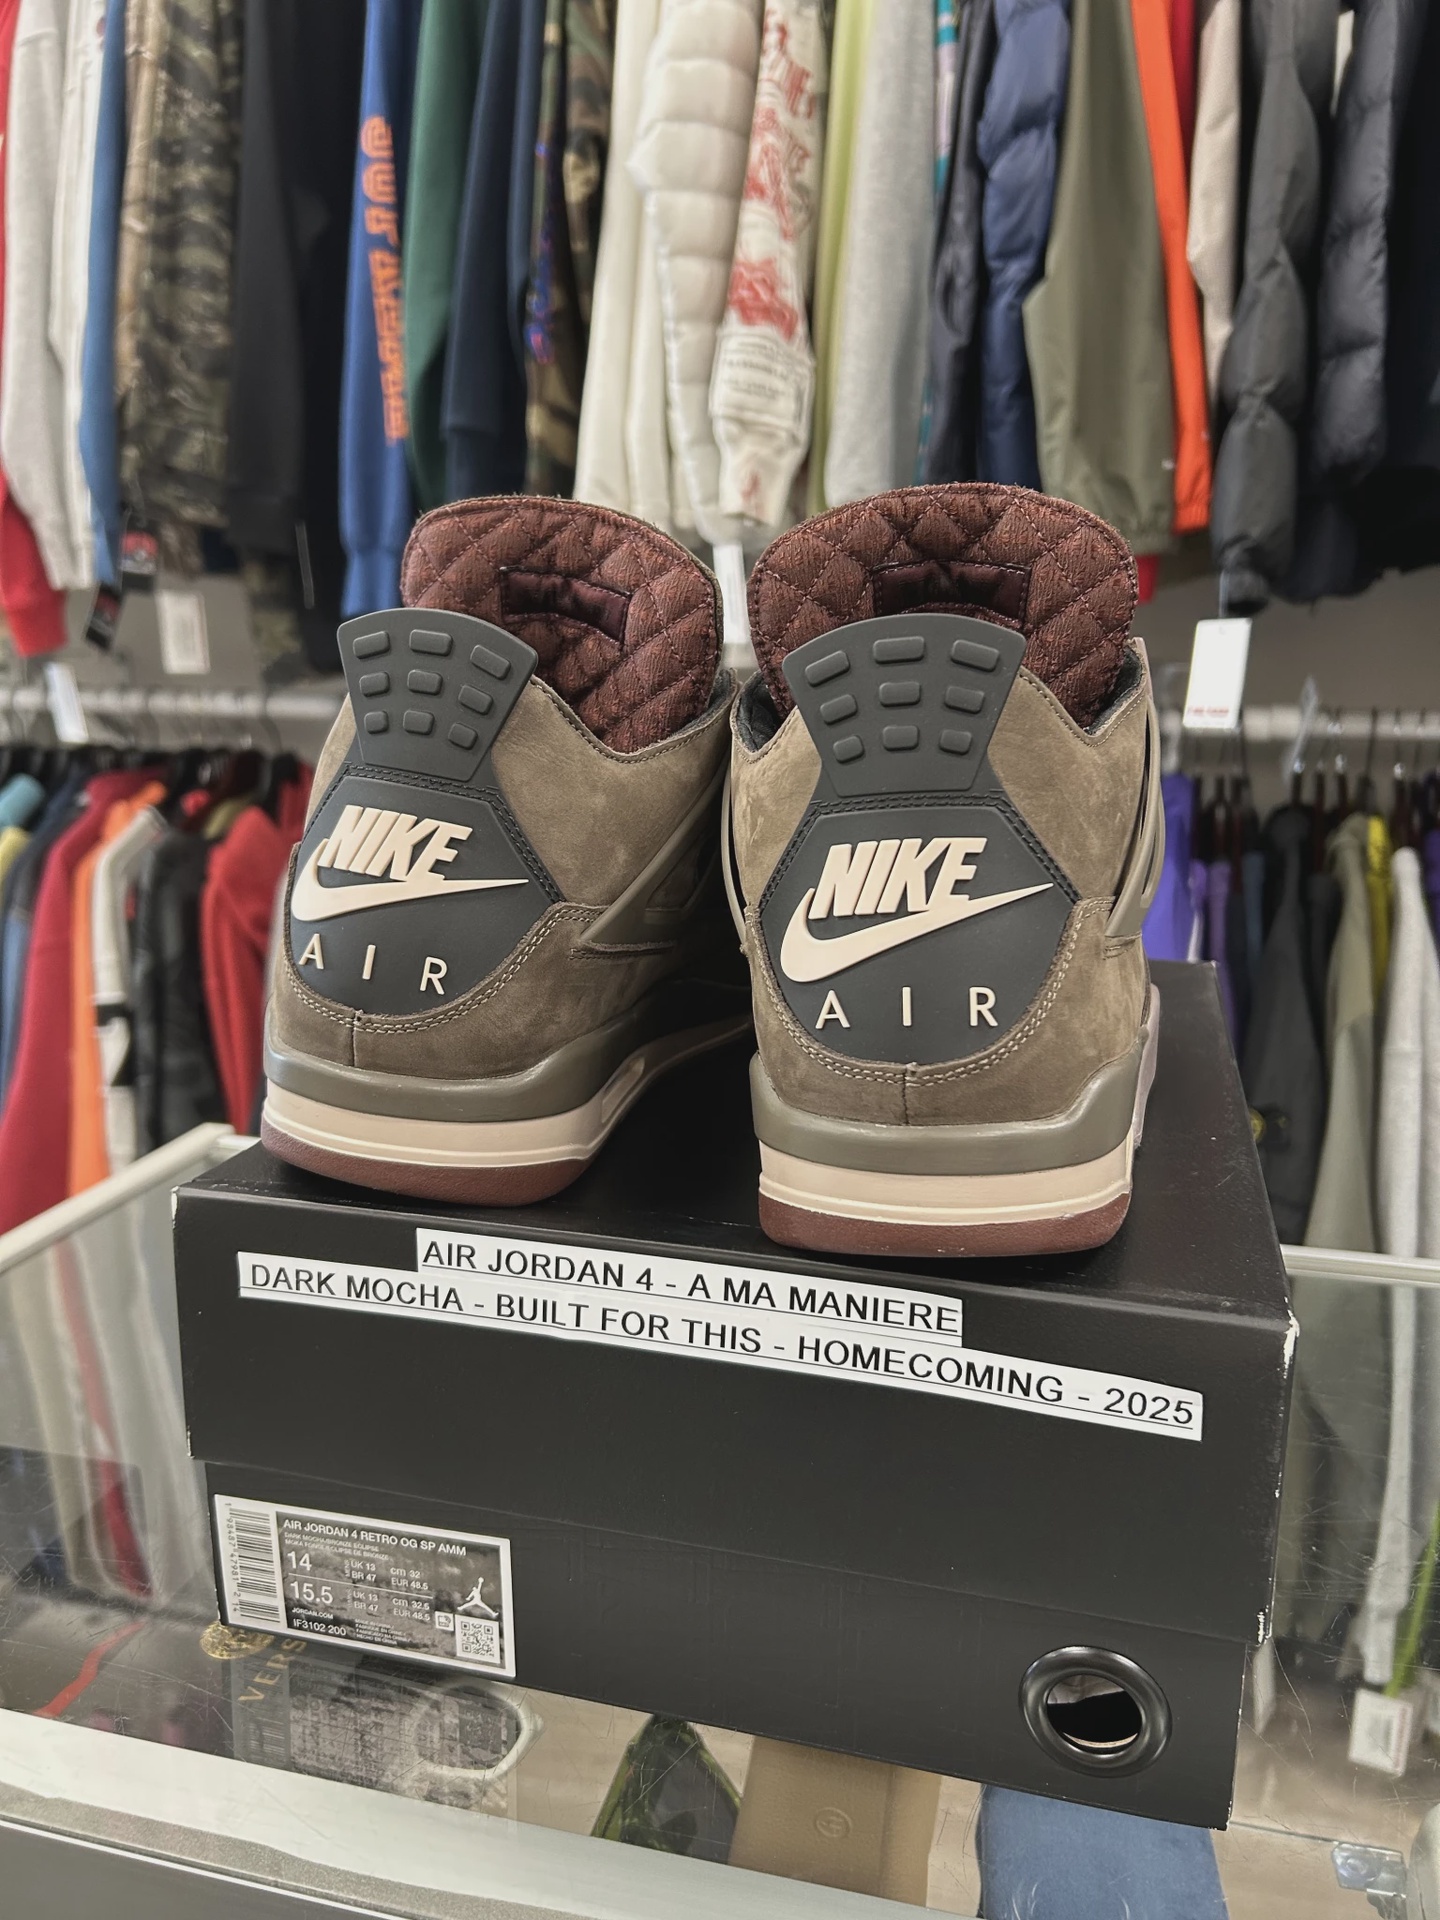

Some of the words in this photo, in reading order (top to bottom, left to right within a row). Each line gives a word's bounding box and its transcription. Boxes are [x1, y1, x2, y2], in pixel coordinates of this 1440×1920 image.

[316, 804, 473, 882] NIKE
[808, 837, 988, 920] NIKE
[298, 933, 448, 995] AIR
[815, 986, 998, 1029] AIR
[422, 1240, 477, 1270] AIR
[487, 1248, 624, 1288] JORDAN
[635, 1267, 654, 1292] 4
[687, 1273, 711, 1299] A
[722, 1277, 776, 1307] MA
[789, 1286, 960, 1334] MANIERE
[250, 1264, 337, 1296] DARK
[346, 1274, 464, 1312] MOCHA
[496, 1293, 590, 1328] BUILT
[601, 1307, 670, 1341] FOR
[681, 1317, 762, 1354] THIS
[798, 1335, 1064, 1404] HOMECOMING
[1103, 1387, 1194, 1425] 2025
[283, 1519, 302, 1531] AIR
[304, 1523, 349, 1538] JORDAN
[351, 1530, 358, 1539] 4
[360, 1531, 398, 1545] RETRO
[400, 1538, 418, 1549] OG
[420, 1541, 436, 1551] SP
[438, 1543, 467, 1556] AMM
[287, 1551, 312, 1571] 14
[351, 1561, 364, 1570] UK
[366, 1563, 376, 1571] 13
[351, 1571, 364, 1580] BR
[366, 1573, 377, 1582] 47
[390, 1567, 406, 1576] cm
[409, 1570, 421, 1579] 32
[290, 1581, 334, 1604] 15.5
[391, 1578, 409, 1587] EUR
[410, 1581, 429, 1591] 48.5
[353, 1590, 366, 1600] UK
[368, 1593, 378, 1602] 13
[392, 1598, 408, 1607] cm
[411, 1601, 430, 1611] 32.5
[292, 1607, 334, 1620] JORDAN.COM
[354, 1601, 367, 1610] BR
[368, 1603, 379, 1612] 47
[393, 1608, 411, 1618] EUR
[412, 1611, 431, 1621] 48.5
[293, 1619, 326, 1632] IF3102
[328, 1624, 346, 1636] 200
